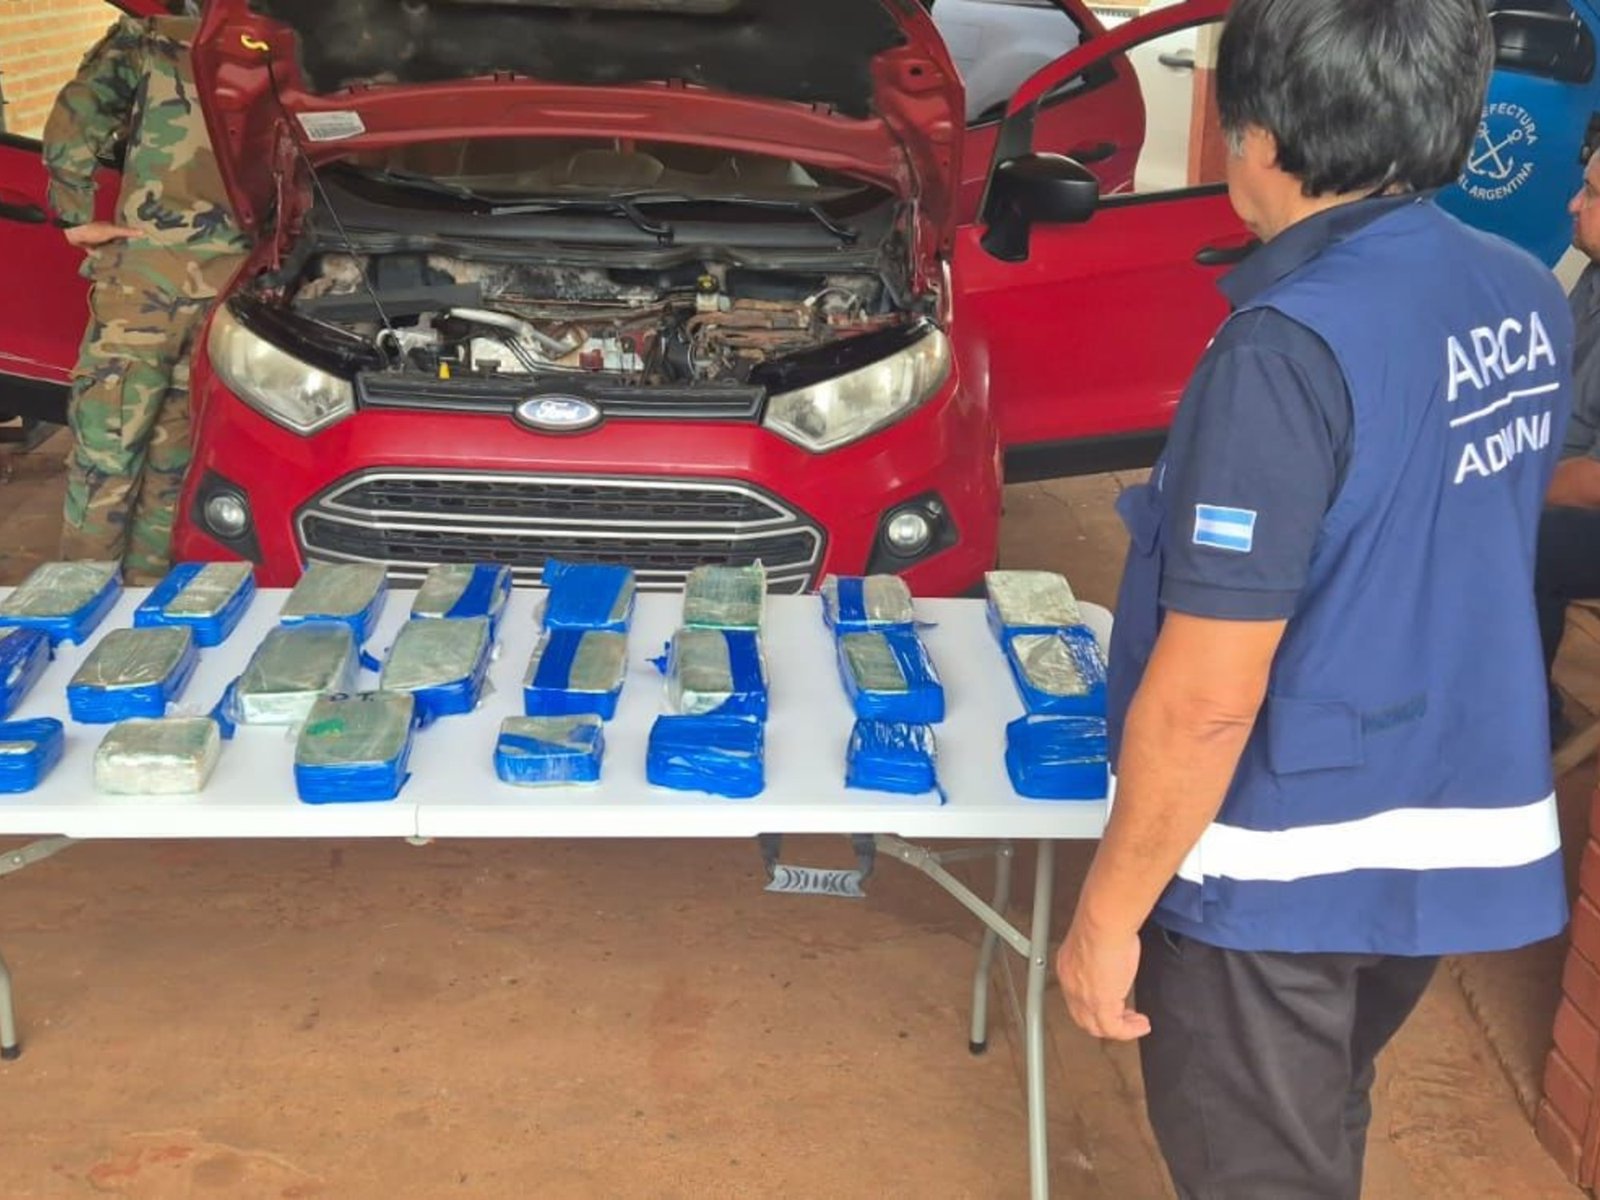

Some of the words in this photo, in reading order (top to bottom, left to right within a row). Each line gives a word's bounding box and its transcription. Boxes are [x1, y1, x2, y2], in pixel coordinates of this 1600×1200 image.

[1468, 162, 1534, 200] ARGENTINA
[1447, 311, 1556, 401] ARCA
[538, 400, 580, 420] Ford
